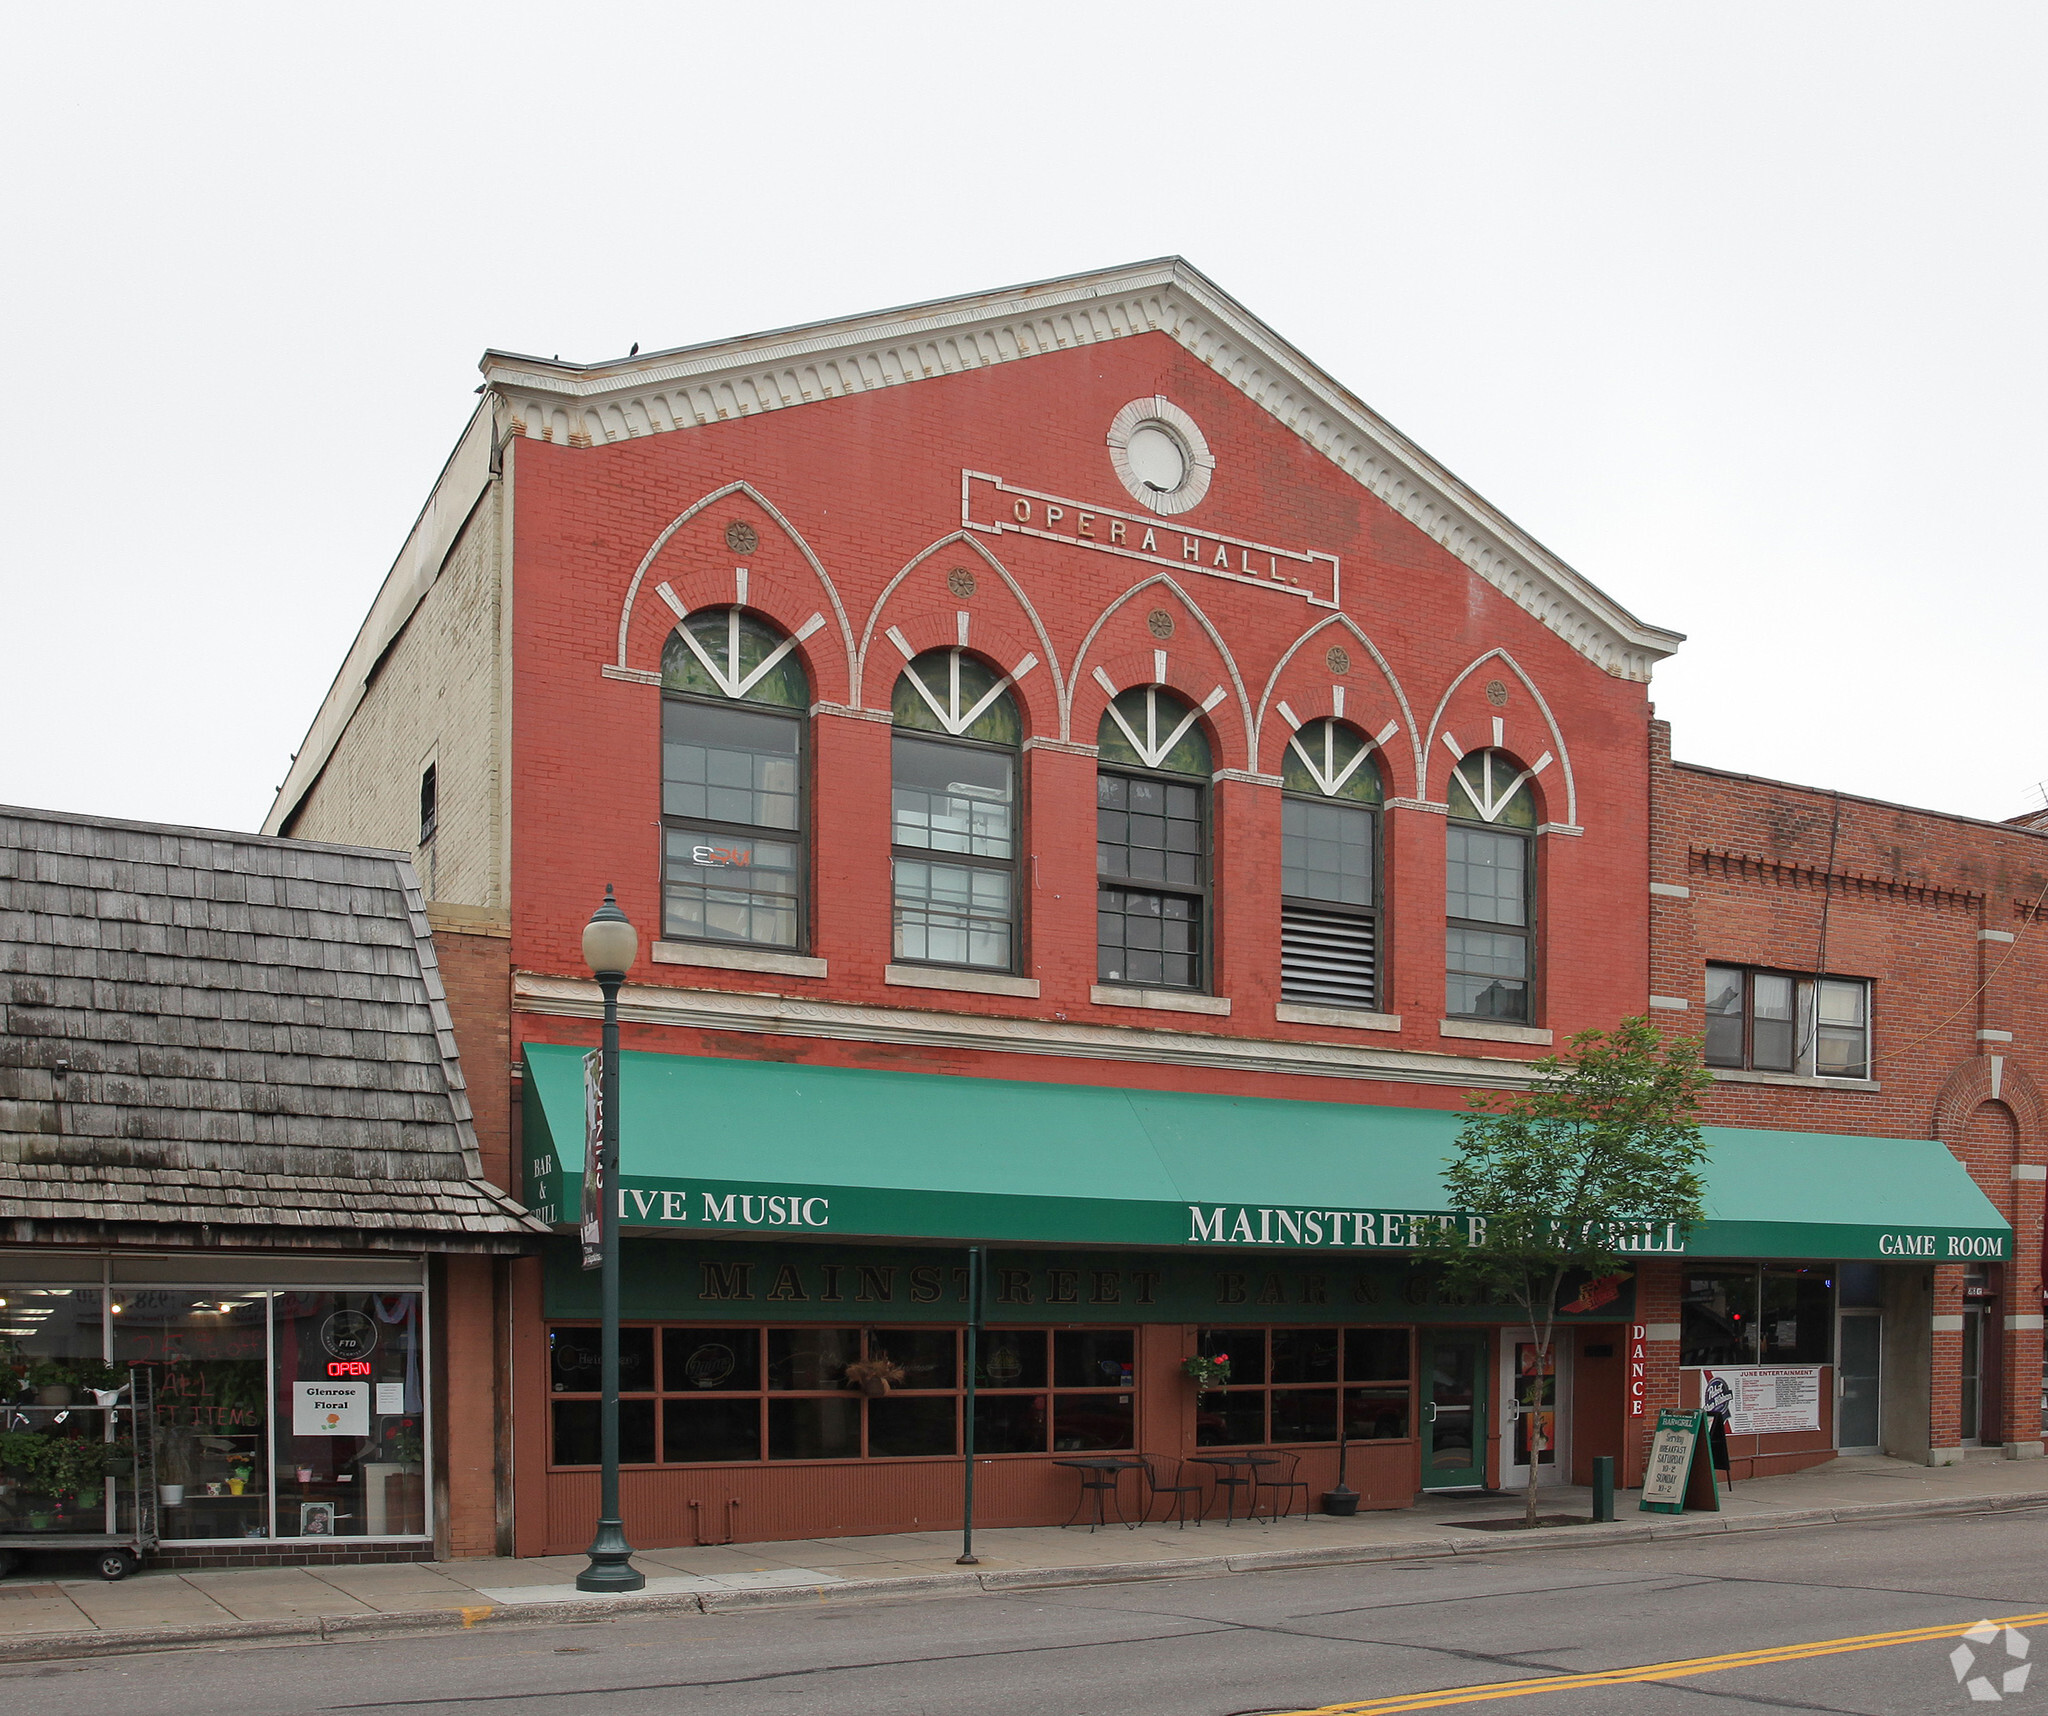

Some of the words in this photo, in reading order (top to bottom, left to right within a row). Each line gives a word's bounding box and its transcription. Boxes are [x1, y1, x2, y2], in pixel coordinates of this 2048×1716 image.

[1013, 498, 1158, 552] OPERA
[1182, 535, 1298, 585] HALL.
[533, 1154, 552, 1179] BAR
[539, 1181, 547, 1200] &
[618, 1188, 687, 1221] IVE
[701, 1192, 829, 1226] MUSIC
[1879, 1233, 1936, 1255] GAME
[1947, 1236, 2003, 1257] ROOM
[1215, 1270, 1331, 1306] BAR
[339, 1339, 357, 1348] FTD
[328, 1362, 371, 1376] OPEN
[1632, 1325, 1646, 1415] DANCE
[1759, 1369, 1813, 1377] ENTERTAINMENT
[306, 1387, 356, 1396] Glenrose
[314, 1401, 348, 1409] Floral
[188, 1405, 258, 1427] ITEMS
[1660, 1444, 1687, 1454] BREAKFAST
[1657, 1454, 1685, 1465] SATURDAY
[1656, 1473, 1677, 1484] SUNDAY
